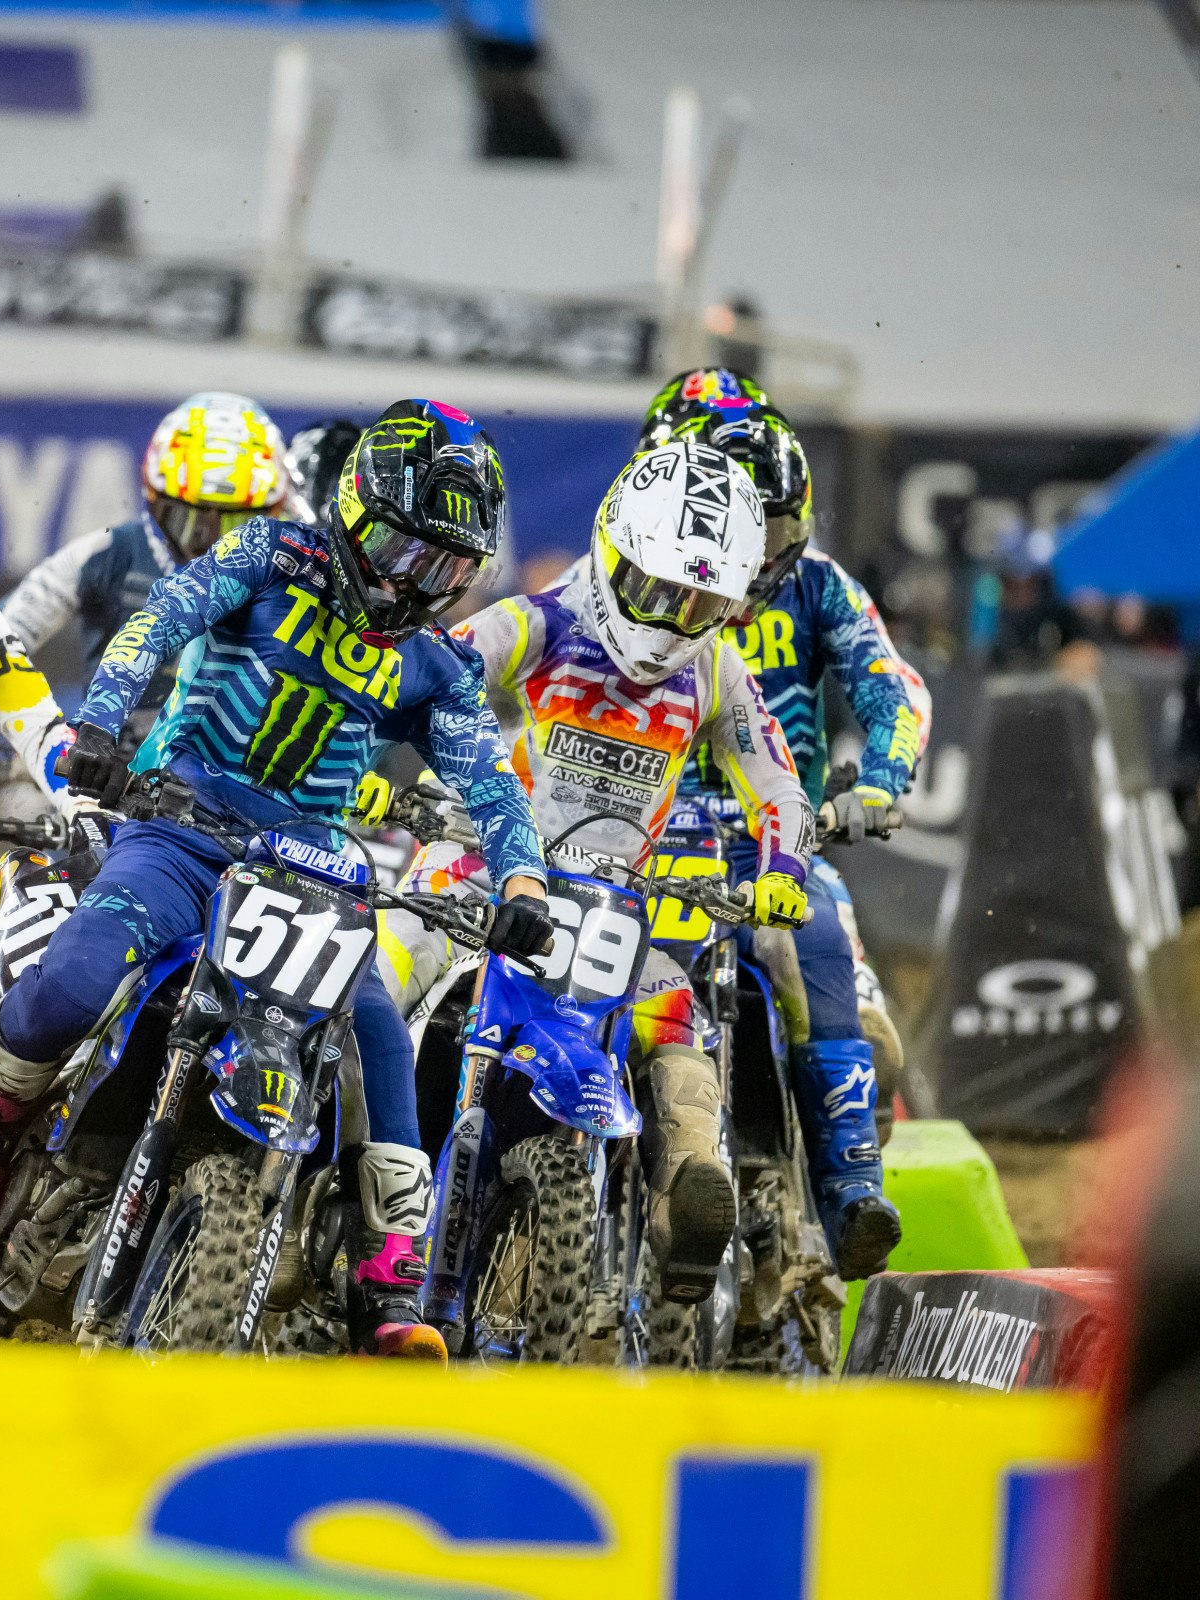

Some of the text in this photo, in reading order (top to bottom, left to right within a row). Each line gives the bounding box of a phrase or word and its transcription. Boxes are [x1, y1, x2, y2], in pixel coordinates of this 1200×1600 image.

[277, 554, 296, 572] 100%
[273, 583, 404, 710] THOR
[568, 646, 603, 660] YAMAHA
[719, 608, 798, 677] OR
[554, 731, 663, 781] Muc-Off
[888, 704, 920, 773] THOR
[277, 835, 355, 881] PROTAPER
[296, 878, 341, 900] MONSTER
[706, 905, 742, 923] ARC
[222, 884, 375, 1009] 511
[448, 927, 484, 950] ARC
[587, 1103, 614, 1115] YAMA
[453, 1132, 480, 1142] DUBYA
[102, 1152, 153, 1279] DUNLOP
[239, 1210, 285, 1342] DUNLOP
